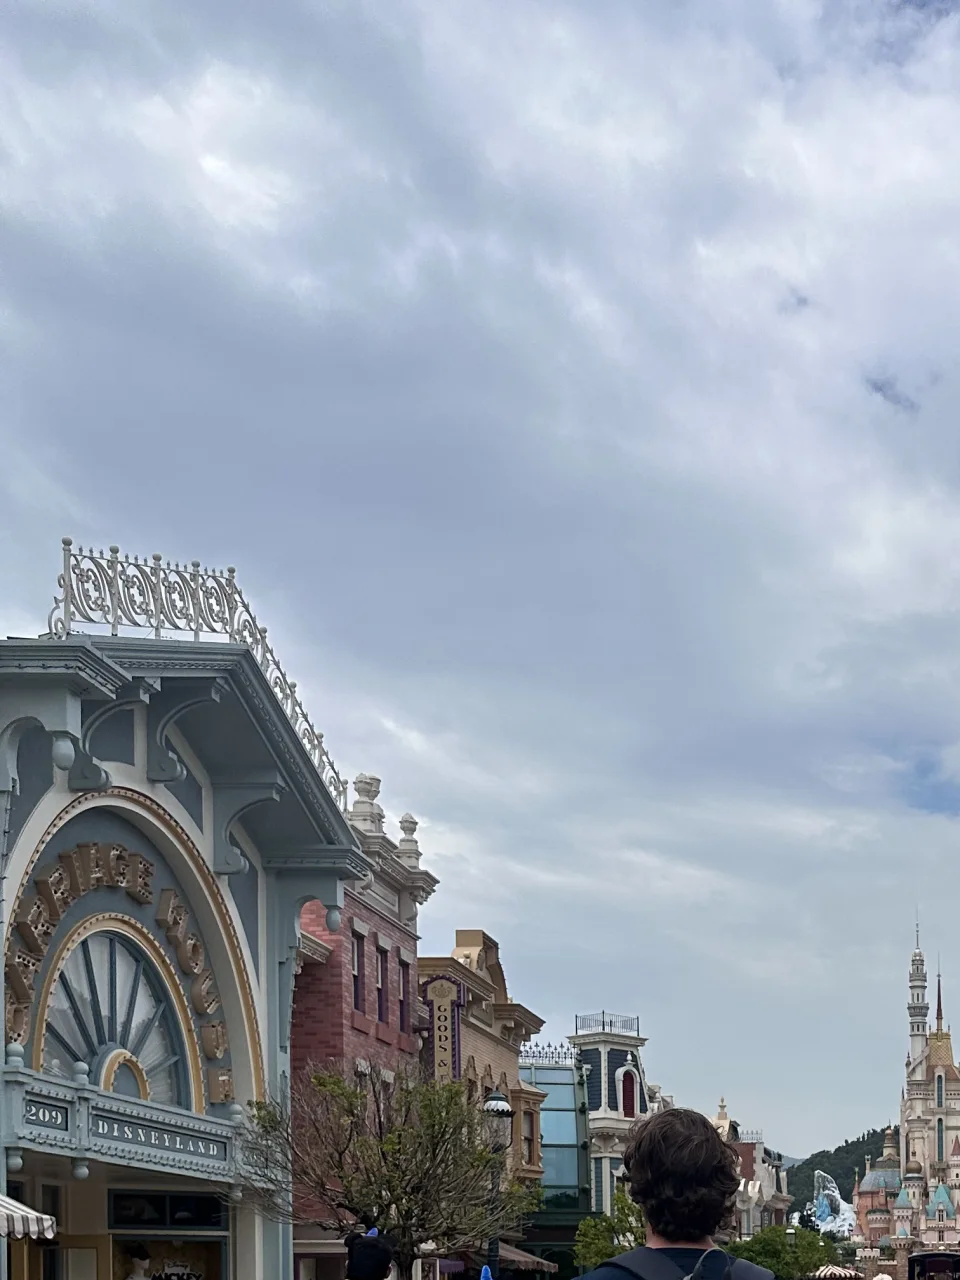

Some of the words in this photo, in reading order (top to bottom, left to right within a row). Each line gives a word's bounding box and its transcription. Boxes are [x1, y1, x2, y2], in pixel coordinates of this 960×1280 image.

[437, 1004, 449, 1053] GOODS
[25, 1104, 63, 1126] 209
[97, 1119, 218, 1157] DISNEYLAND
